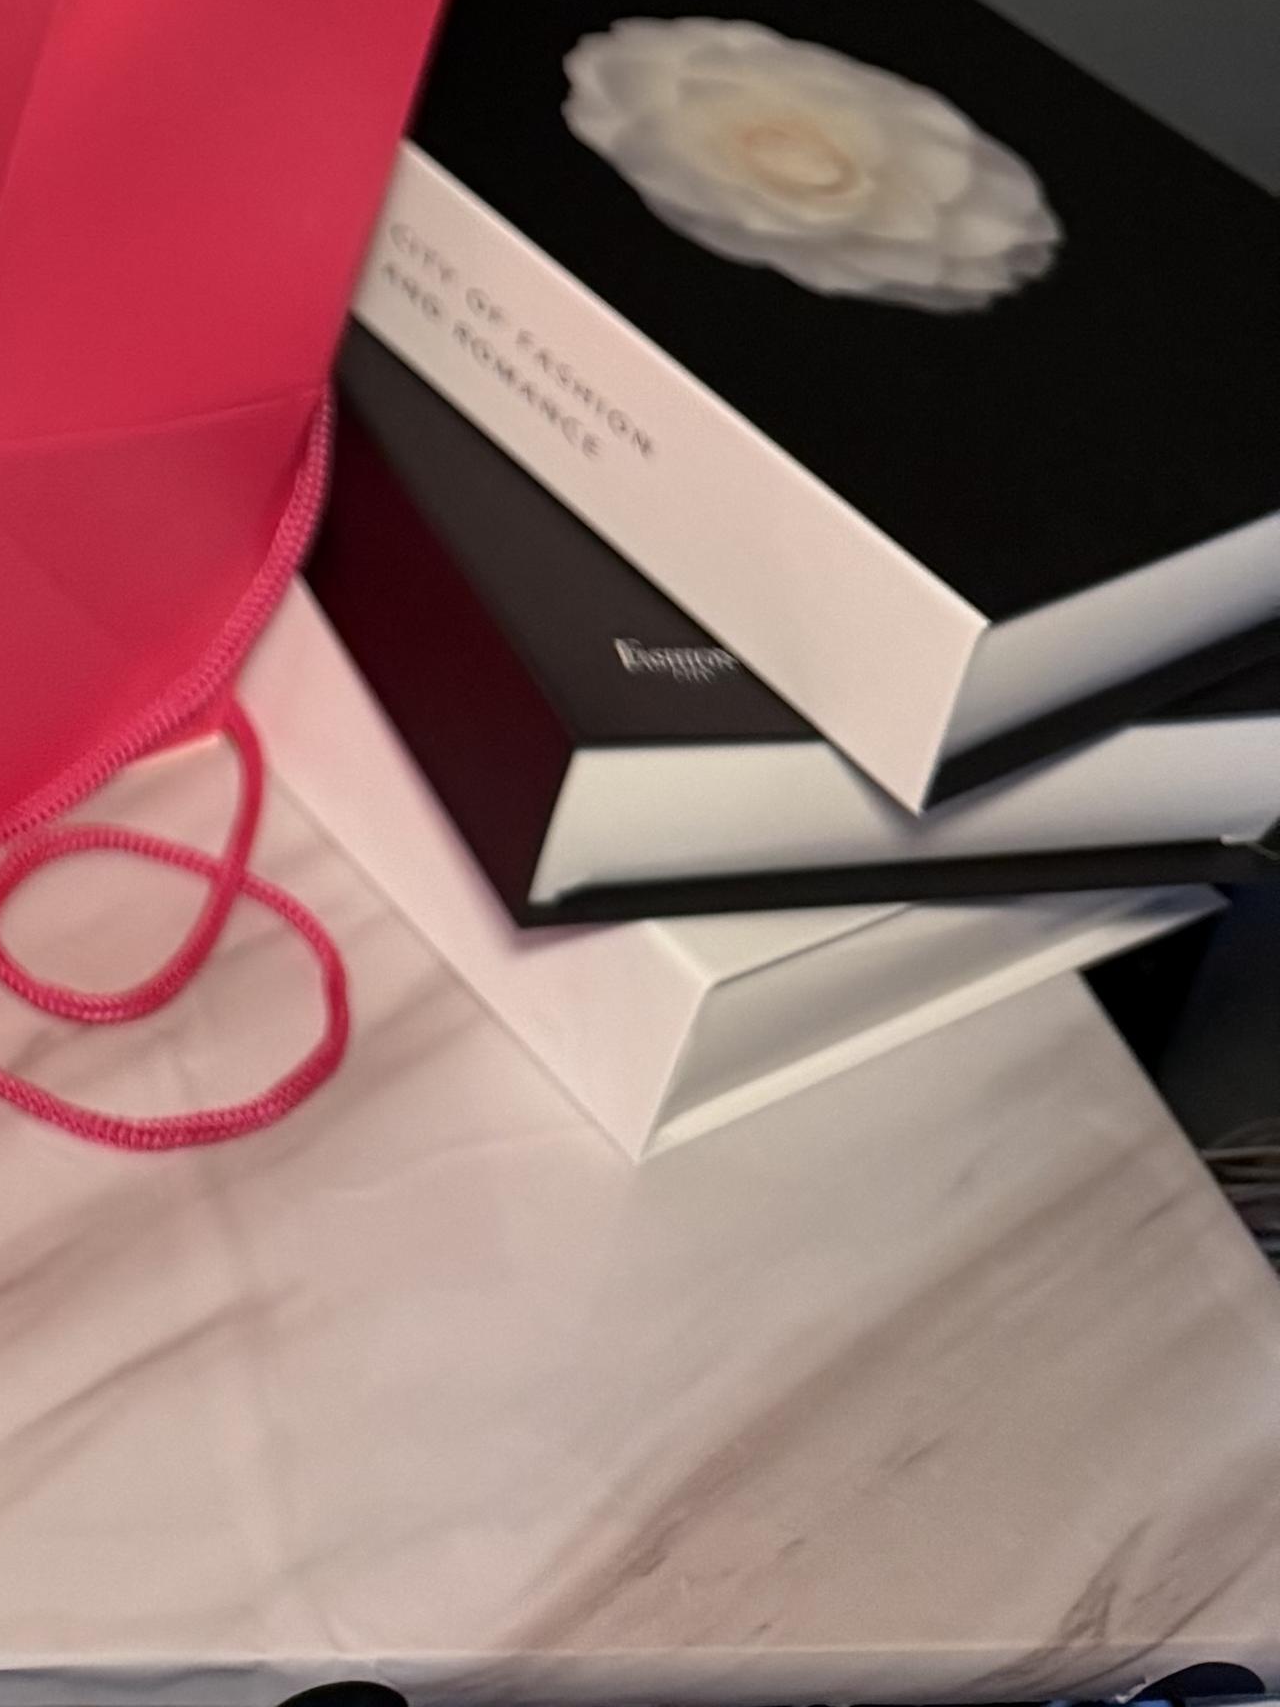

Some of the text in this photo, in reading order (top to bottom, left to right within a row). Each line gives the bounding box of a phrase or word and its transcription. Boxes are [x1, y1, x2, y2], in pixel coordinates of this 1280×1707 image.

[381, 263, 603, 459] AND ROMANCE
[465, 286, 504, 324] OF
[515, 328, 654, 459] FASHION
